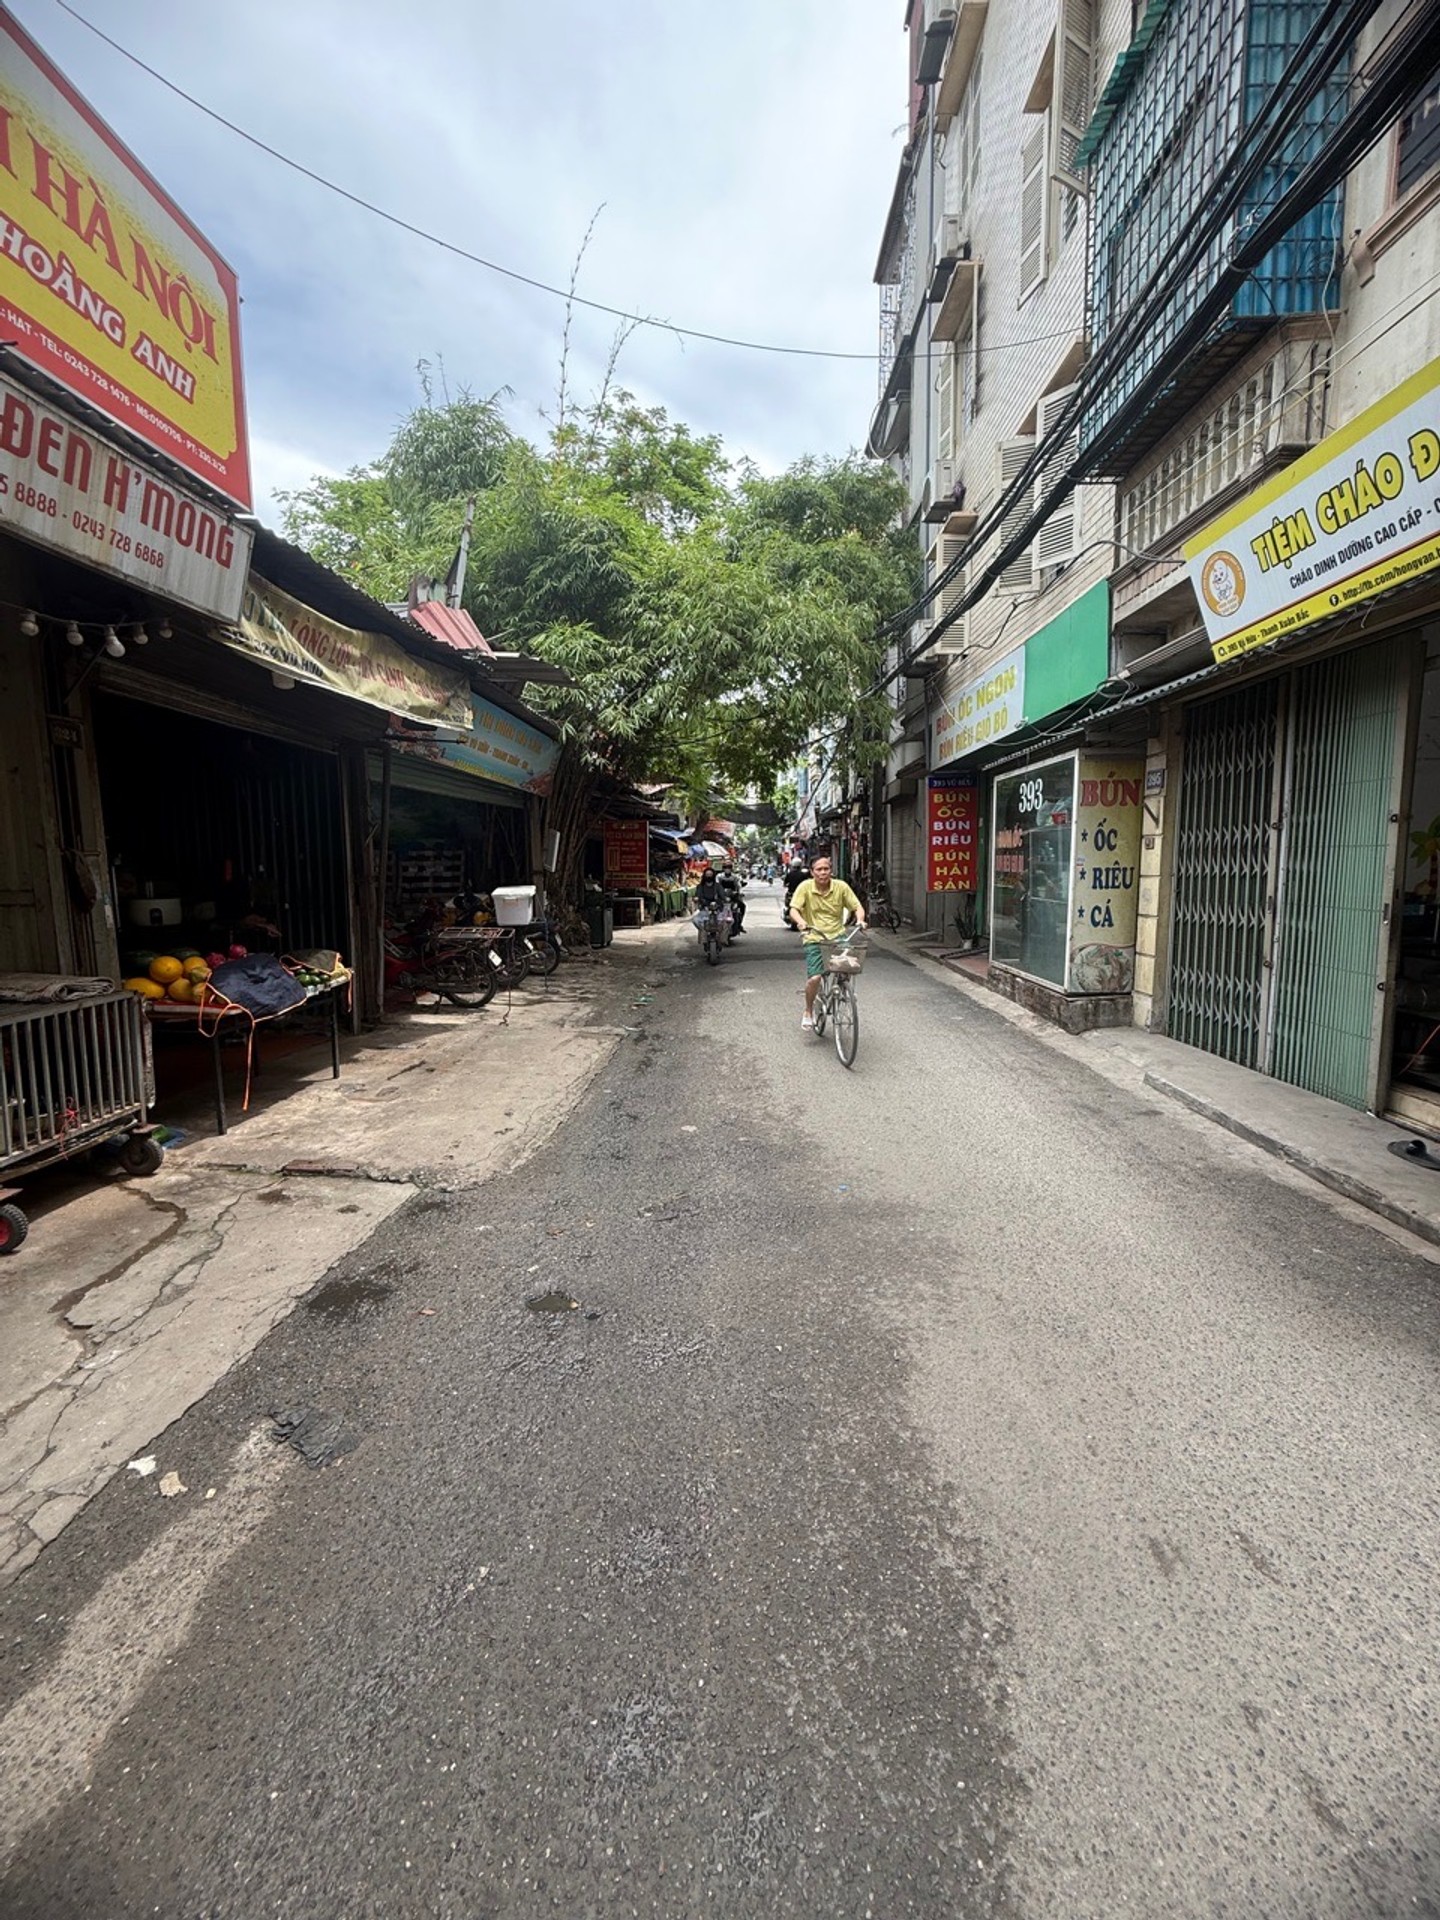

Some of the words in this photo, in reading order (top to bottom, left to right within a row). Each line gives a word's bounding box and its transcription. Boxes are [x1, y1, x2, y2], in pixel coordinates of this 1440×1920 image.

[26, 127, 128, 281] HÀ
[129, 232, 219, 367] NỘI
[0, 214, 124, 344] HOÀNG
[133, 335, 195, 400] ANH
[40, 332, 62, 358] TEL:
[0, 392, 93, 494] ĐEN
[15, 481, 57, 518] 8888
[73, 510, 105, 541] 0243
[110, 528, 131, 553] 728
[135, 541, 164, 569] 6868
[1251, 507, 1316, 570] TIỆM
[1316, 451, 1404, 536] CHÁO
[1314, 555, 1338, 577] DINH
[1374, 522, 1398, 545] CAO
[1398, 505, 1422, 532] CẤP
[976, 664, 1015, 711] NGON
[933, 790, 970, 804] BÚN
[1018, 778, 1043, 813] 393
[1080, 771, 1142, 807] BÚN
[933, 818, 970, 831] BÚN
[937, 804, 967, 818] ỐC
[932, 832, 972, 846] RIÊU
[1093, 817, 1118, 851] ỐC
[933, 848, 970, 862] BÚN
[936, 862, 968, 876] HẢI
[1091, 860, 1135, 890] RIÊU
[1090, 898, 1115, 928] CÁ
